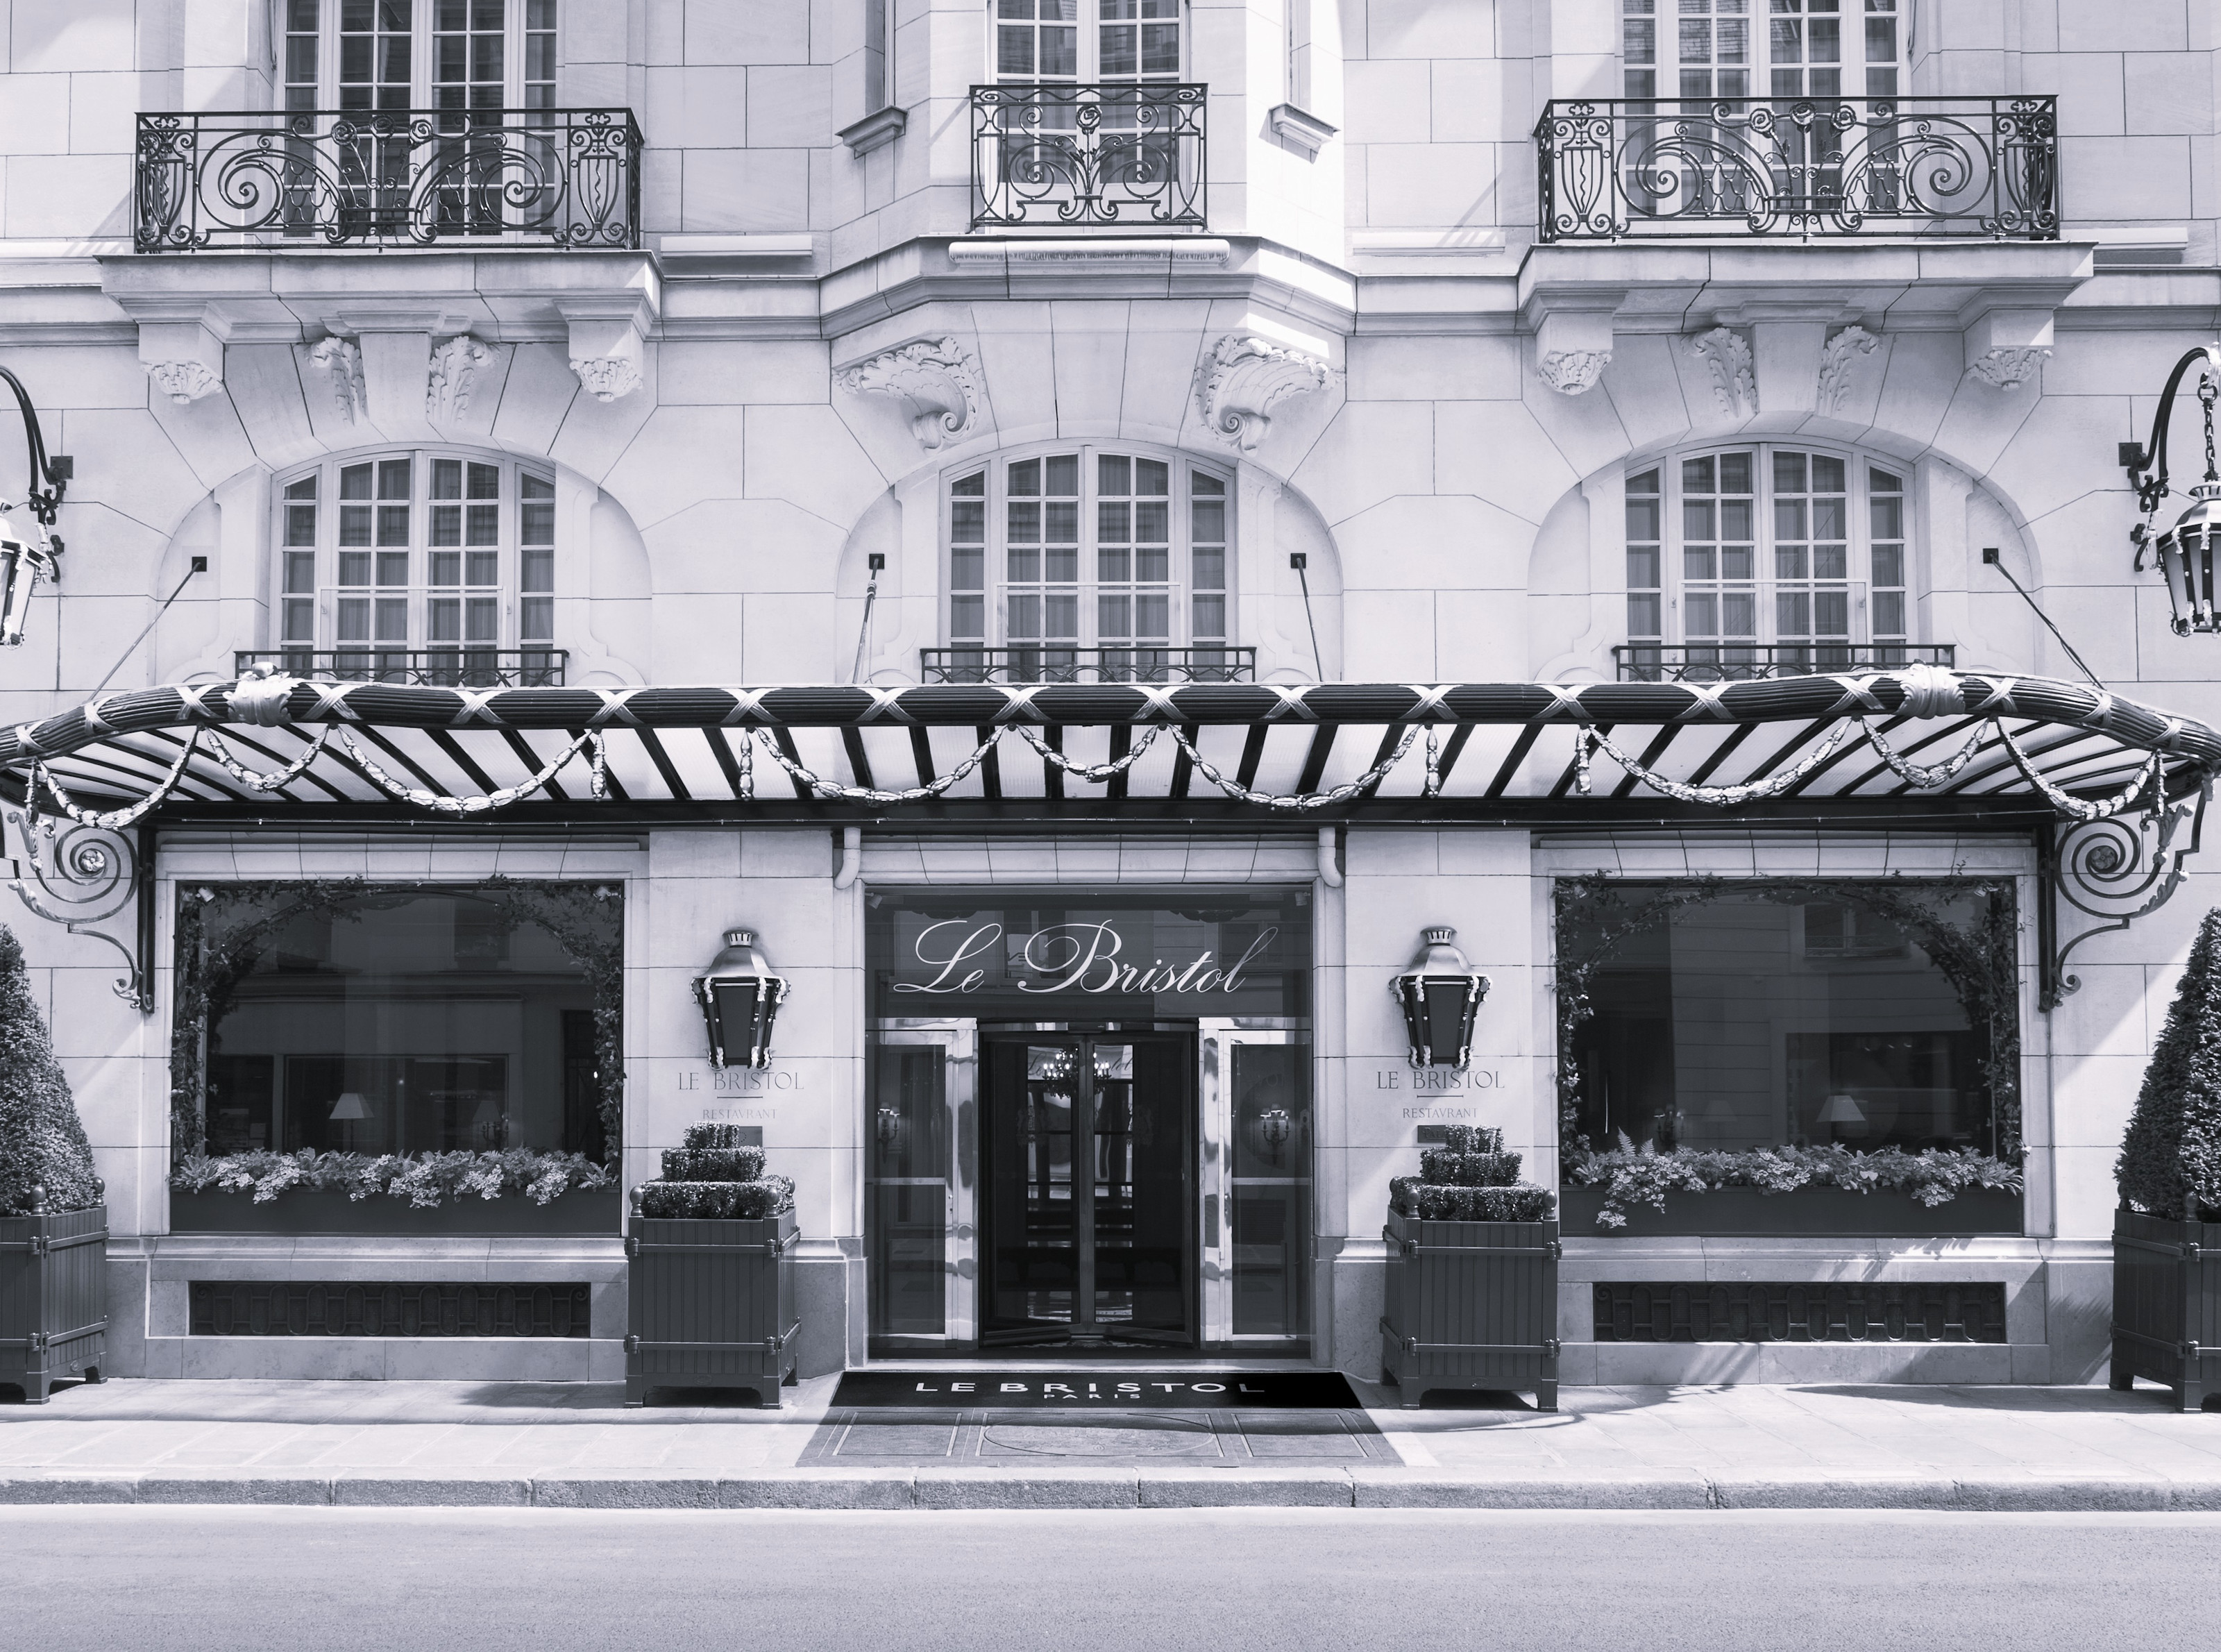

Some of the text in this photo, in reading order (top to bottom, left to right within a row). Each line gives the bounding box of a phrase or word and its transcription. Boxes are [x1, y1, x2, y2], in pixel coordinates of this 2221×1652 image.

[893, 919, 1278, 993] Le Bristol
[678, 1072, 804, 1090] LE BRISTOL
[1377, 1071, 1505, 1089] LE BRISTOL
[916, 1382, 1265, 1392] LE BRISTOL
